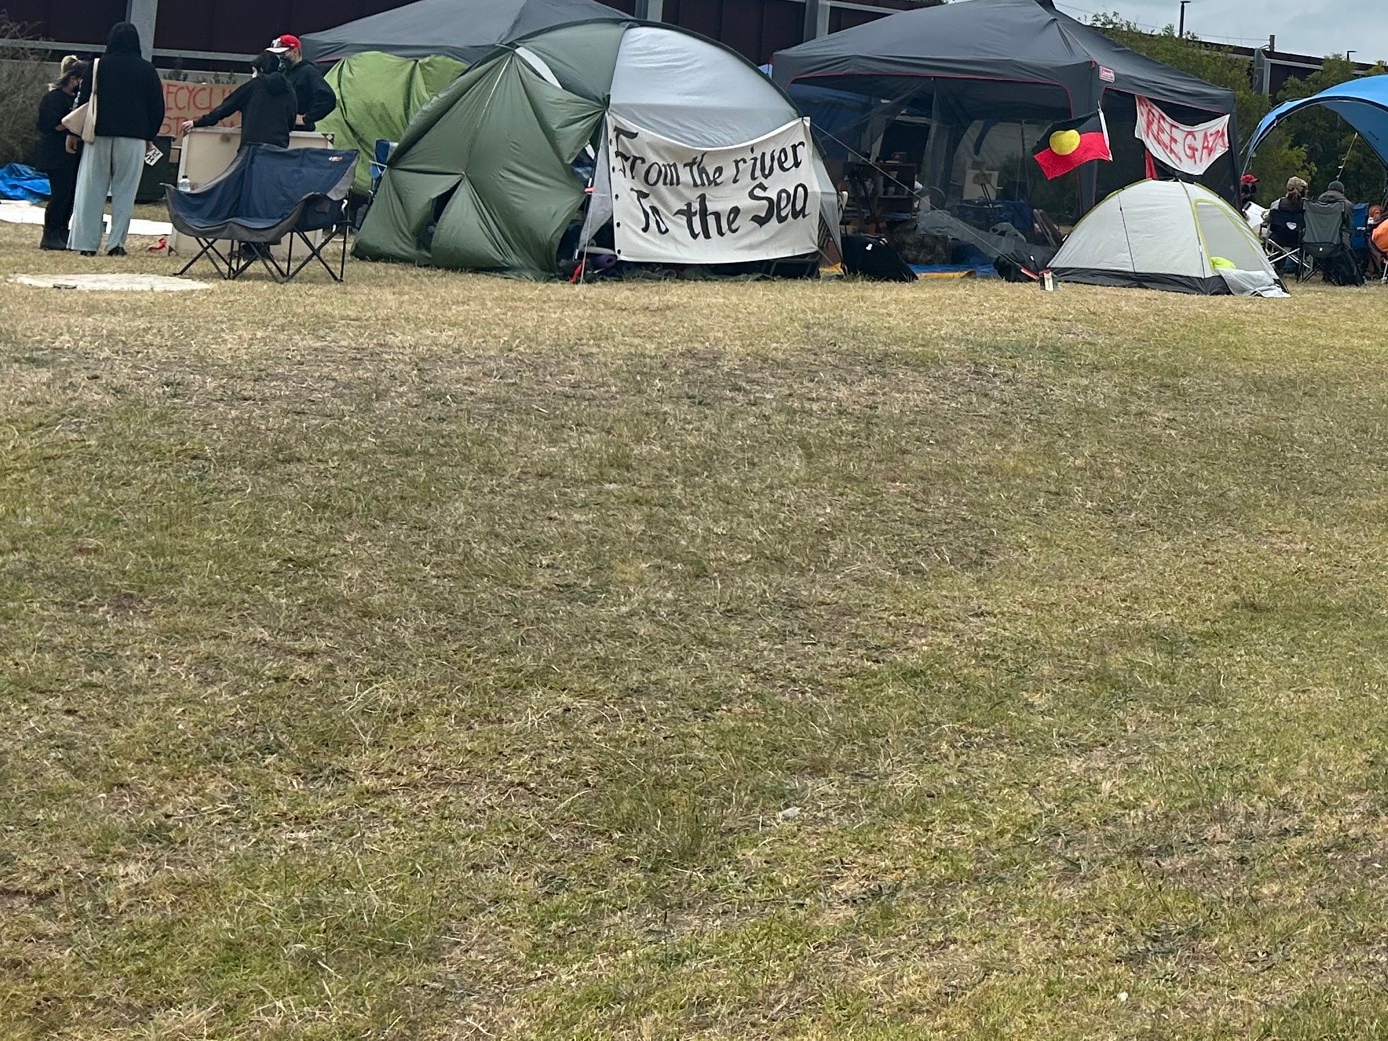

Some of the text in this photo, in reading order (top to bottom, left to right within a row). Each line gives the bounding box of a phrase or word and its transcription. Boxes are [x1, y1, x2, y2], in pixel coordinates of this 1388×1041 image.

[683, 151, 724, 188] the
[732, 141, 806, 185] river
[630, 181, 812, 240] To the Sea
